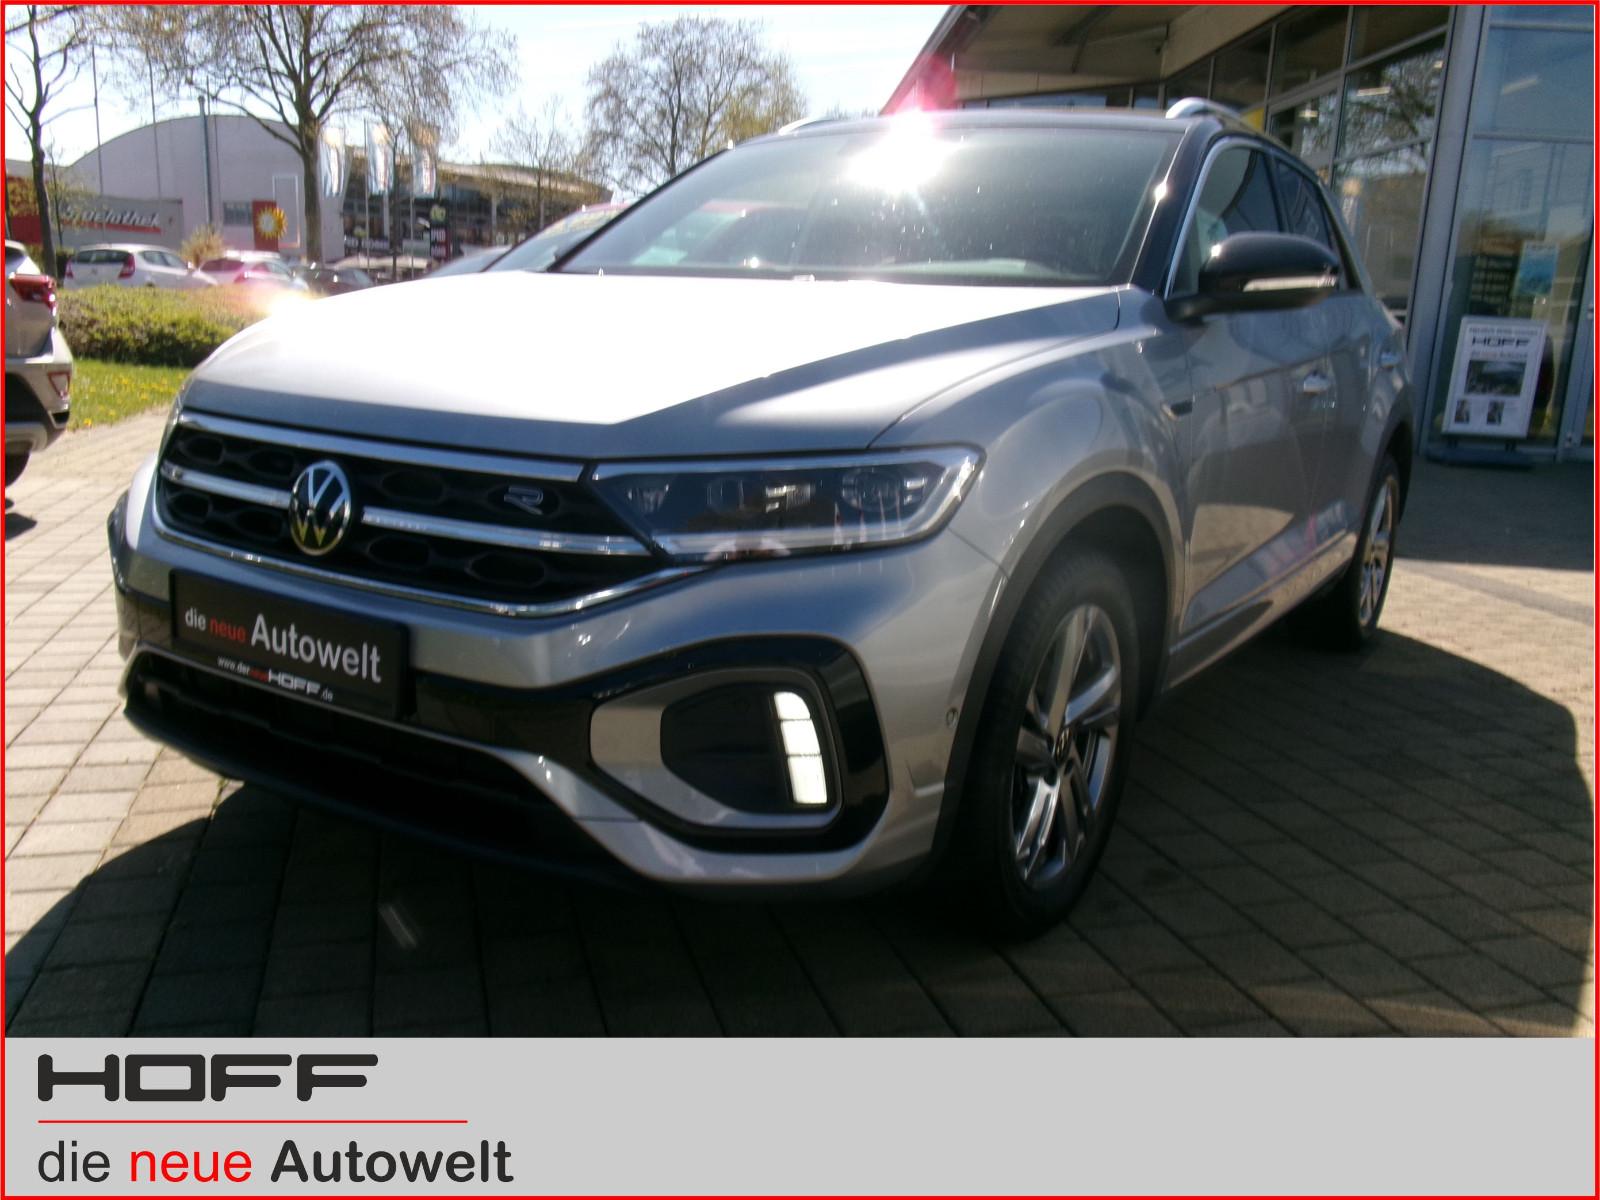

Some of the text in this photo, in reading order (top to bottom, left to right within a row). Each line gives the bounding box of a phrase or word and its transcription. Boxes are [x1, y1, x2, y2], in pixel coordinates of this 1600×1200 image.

[1471, 336, 1531, 348] HOFF
[185, 608, 382, 683] die neue Autowelt
